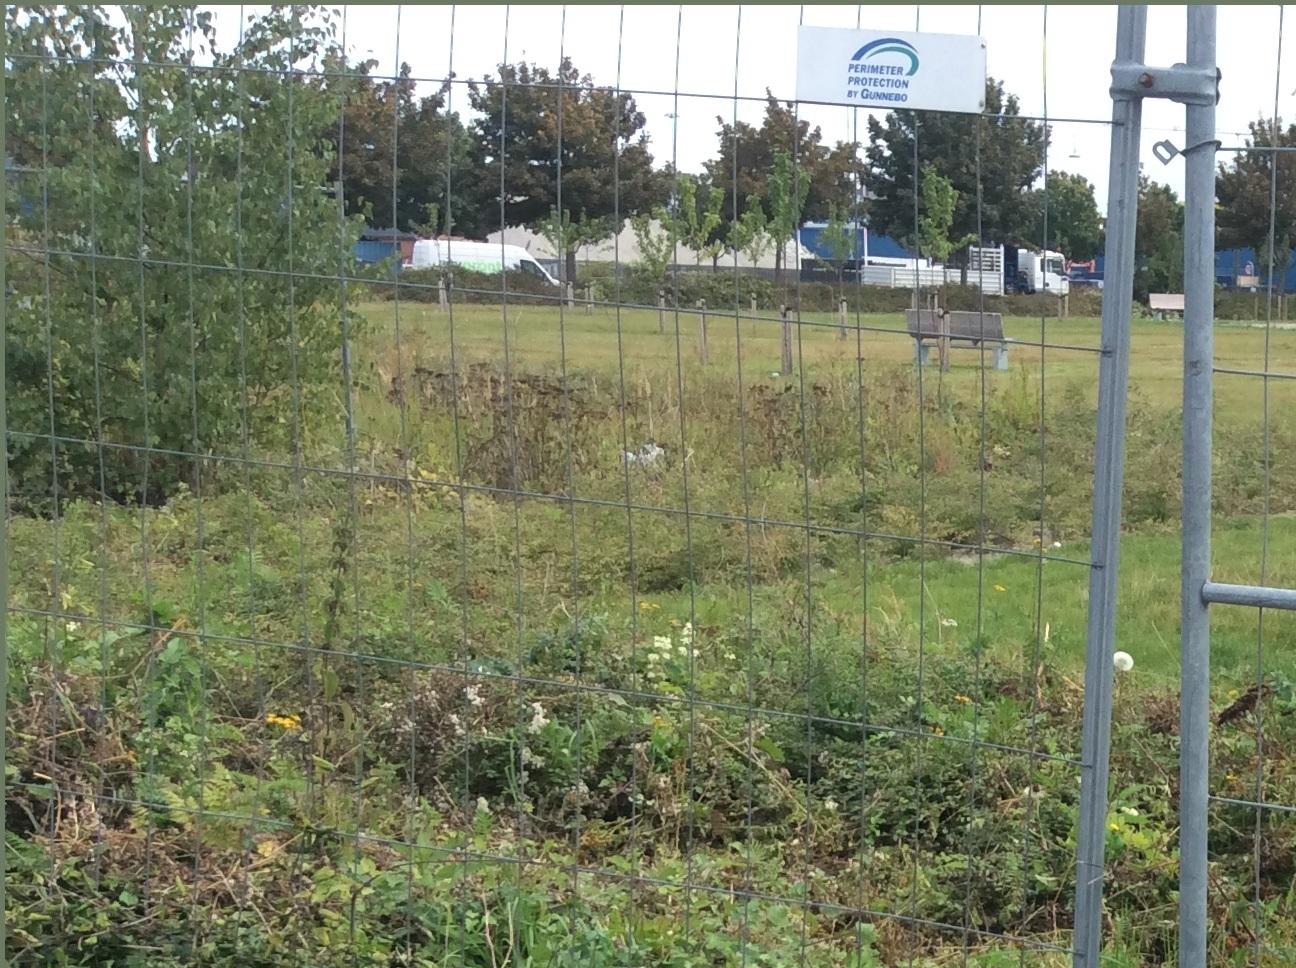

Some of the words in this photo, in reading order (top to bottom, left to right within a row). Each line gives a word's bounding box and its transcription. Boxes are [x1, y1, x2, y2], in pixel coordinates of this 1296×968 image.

[848, 64, 904, 76] PERIMETER
[847, 76, 909, 89] PROTECTION
[847, 90, 859, 98] BY
